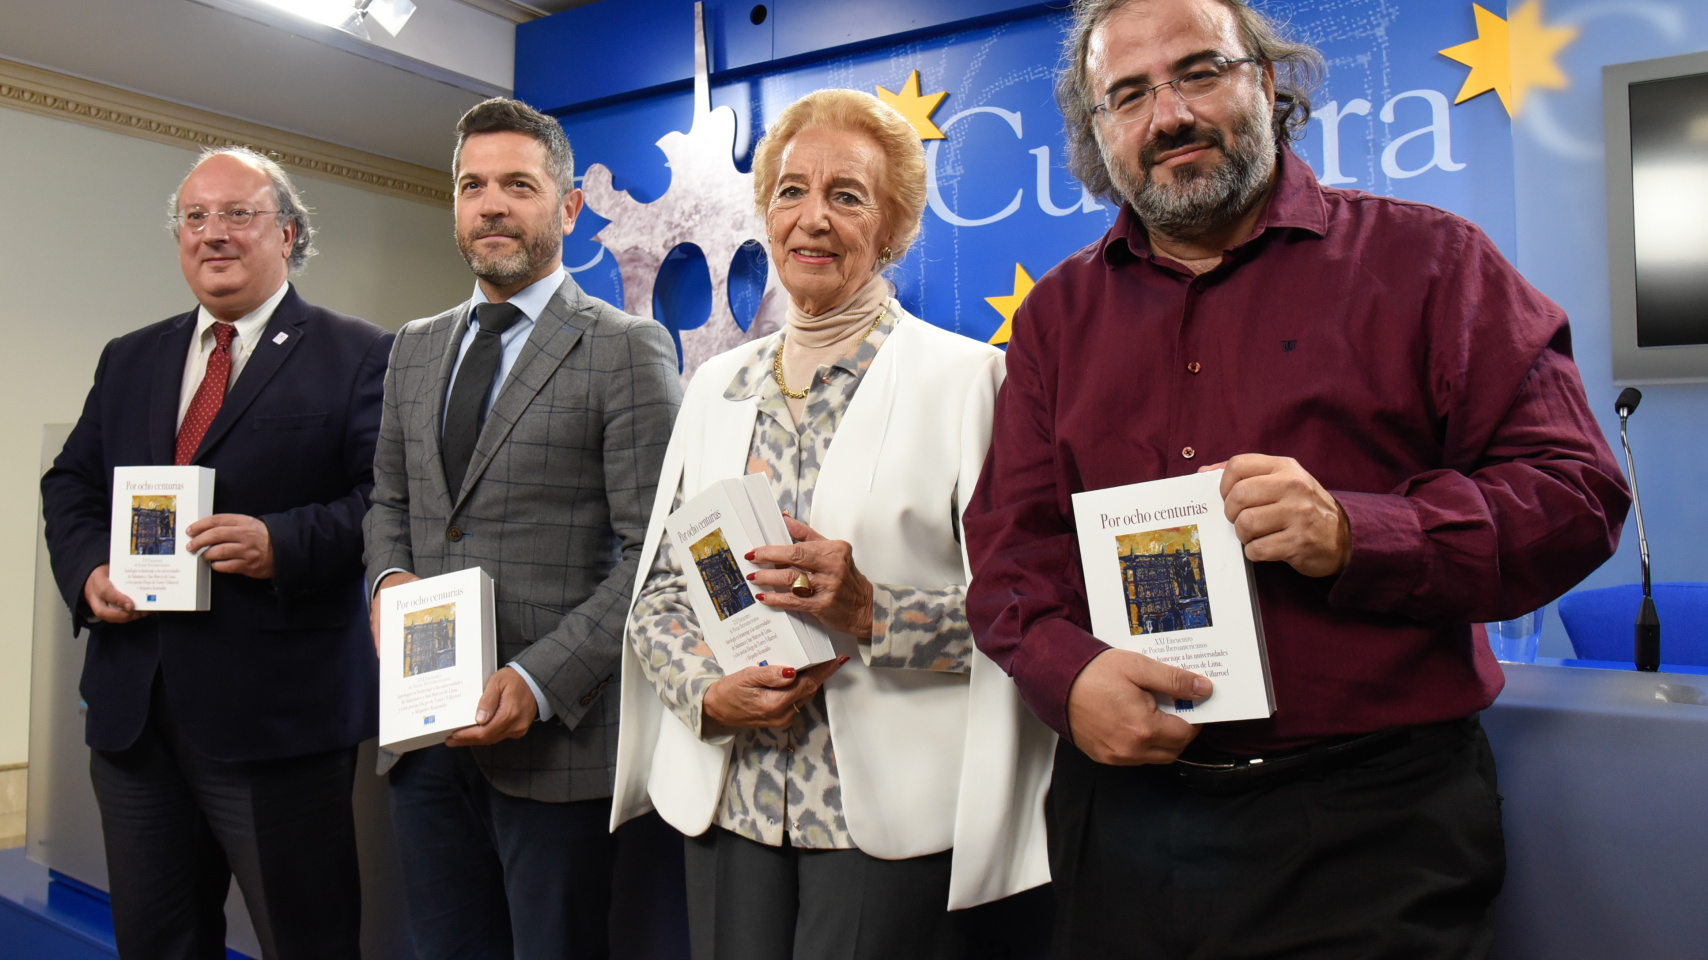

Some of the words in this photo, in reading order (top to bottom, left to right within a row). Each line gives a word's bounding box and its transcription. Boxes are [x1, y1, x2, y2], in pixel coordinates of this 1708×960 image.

[126, 480, 137, 491] Por
[137, 480, 153, 490] ocho
[154, 480, 185, 490] centurias
[1100, 513, 1121, 529] Por
[1123, 508, 1152, 526] ocho
[1154, 500, 1208, 521] centurias
[677, 531, 688, 544] Por
[686, 523, 700, 538] ocho
[698, 509, 722, 531] centurias
[396, 600, 410, 611] Por
[410, 595, 429, 607] ocho
[429, 587, 464, 602] centurias
[1154, 637, 1166, 645] XXI
[1166, 636, 1194, 644] Encuentro
[1148, 645, 1166, 654] Poetas
[1165, 643, 1208, 652] Iberoamericanos
[1156, 654, 1181, 663] homenaje
[1193, 649, 1229, 659] universidades
[1180, 662, 1200, 670] Marcos
[1204, 669, 1230, 678] Villarroel
